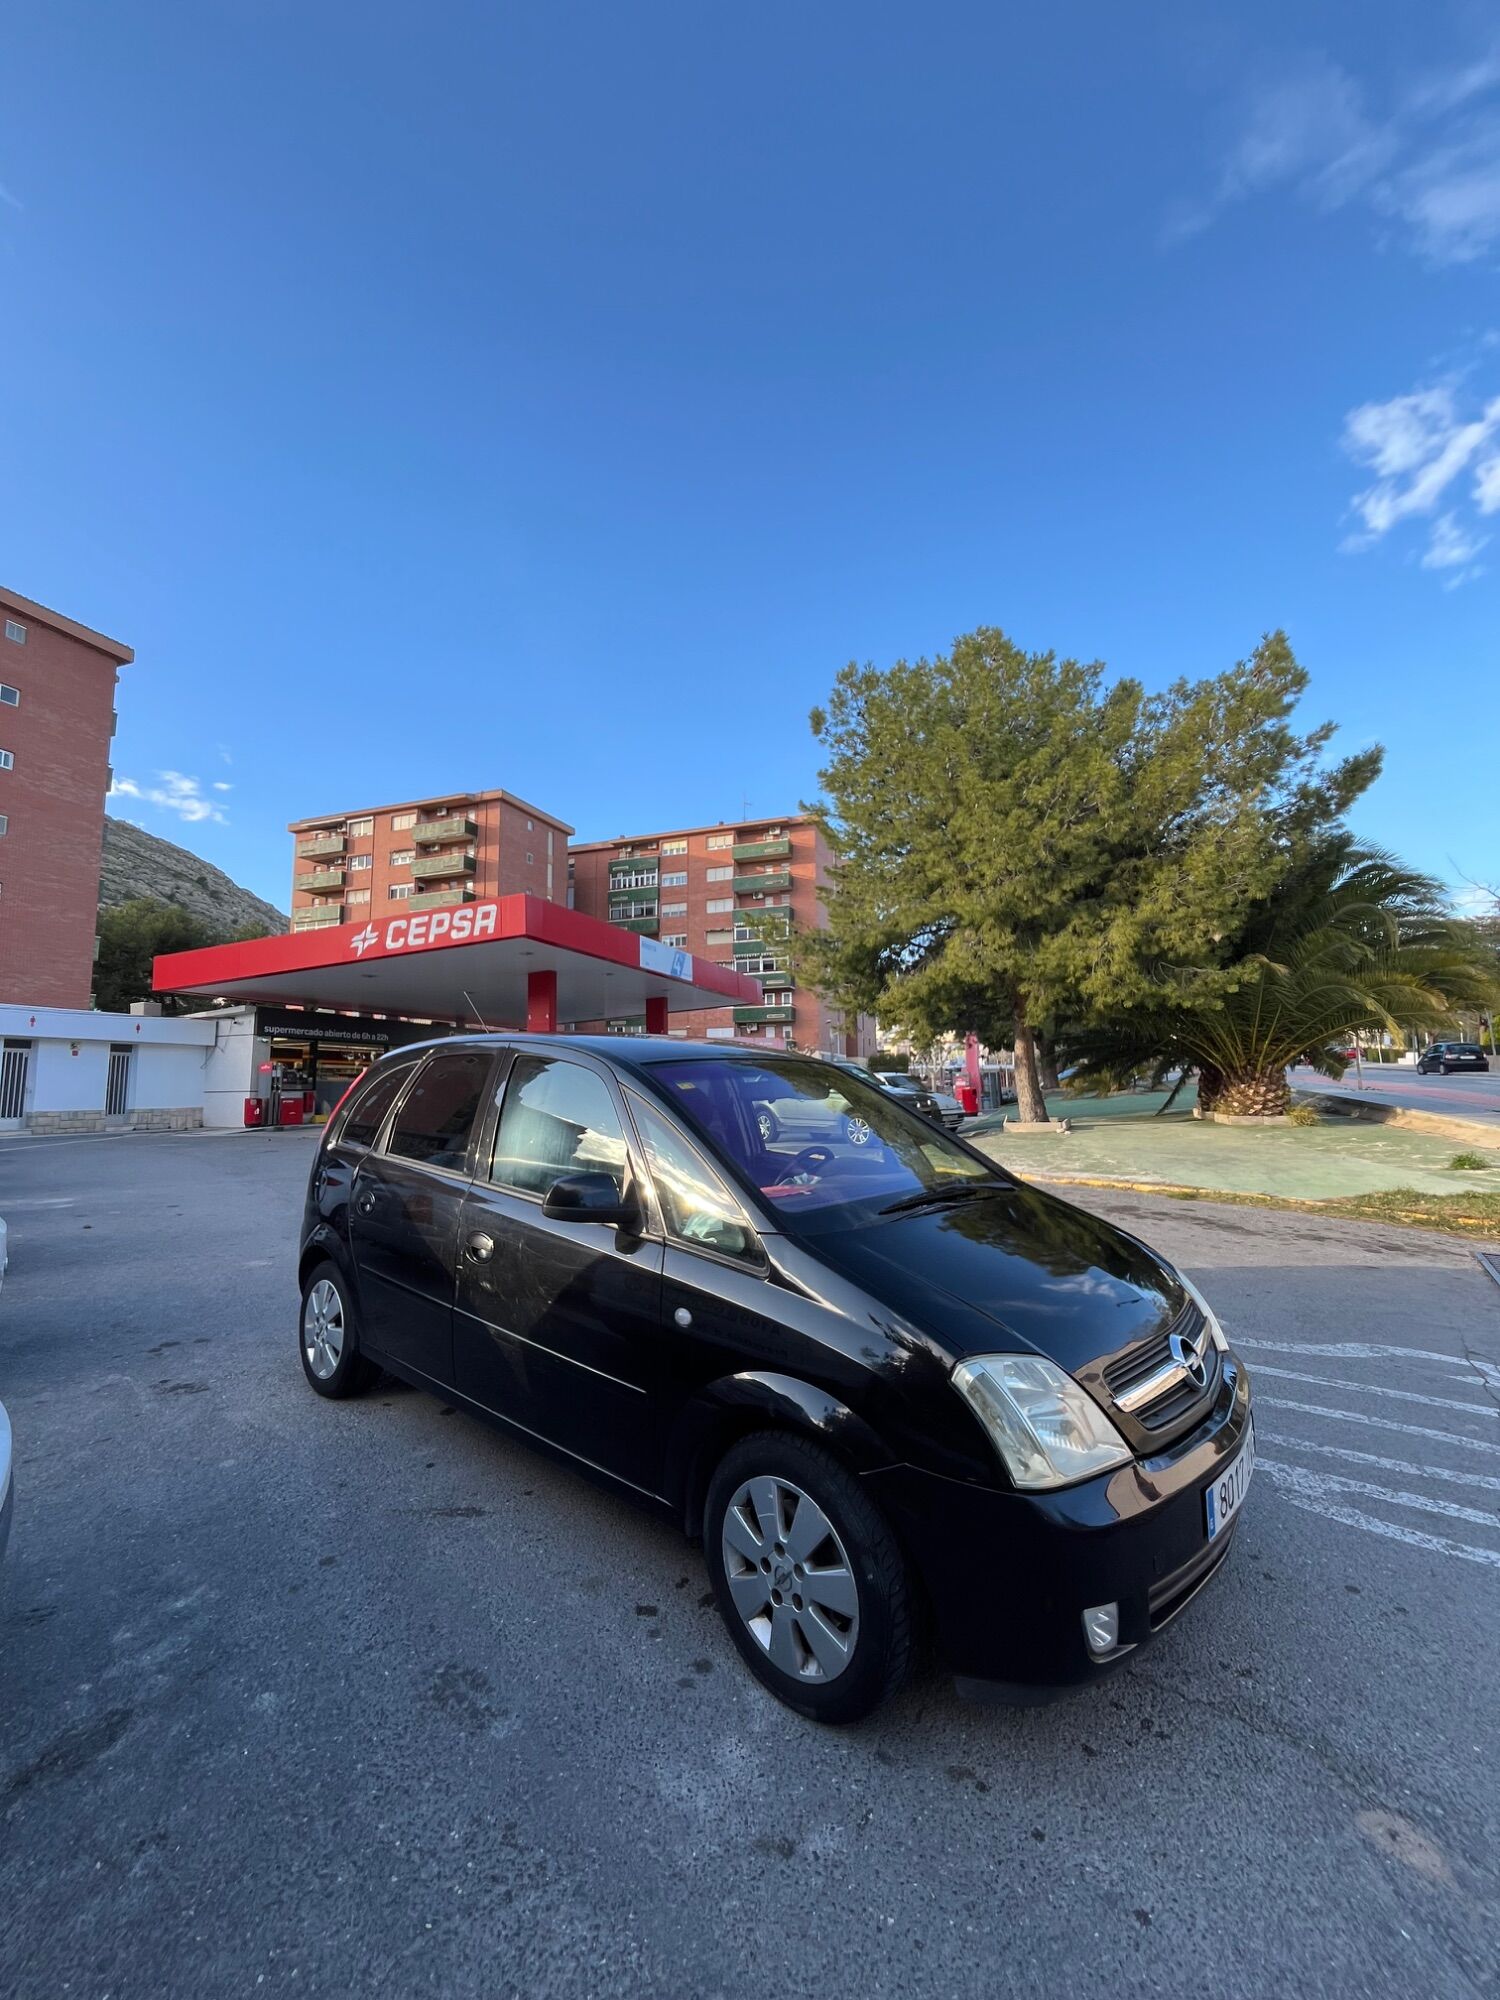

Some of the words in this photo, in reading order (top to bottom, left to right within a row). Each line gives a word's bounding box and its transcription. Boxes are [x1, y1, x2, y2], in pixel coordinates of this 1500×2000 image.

[386, 904, 498, 950] CEPSA
[264, 1025, 323, 1037] supermercado
[324, 1028, 351, 1039] abierto
[352, 1031, 361, 1040] de
[376, 1032, 389, 1041] 22h
